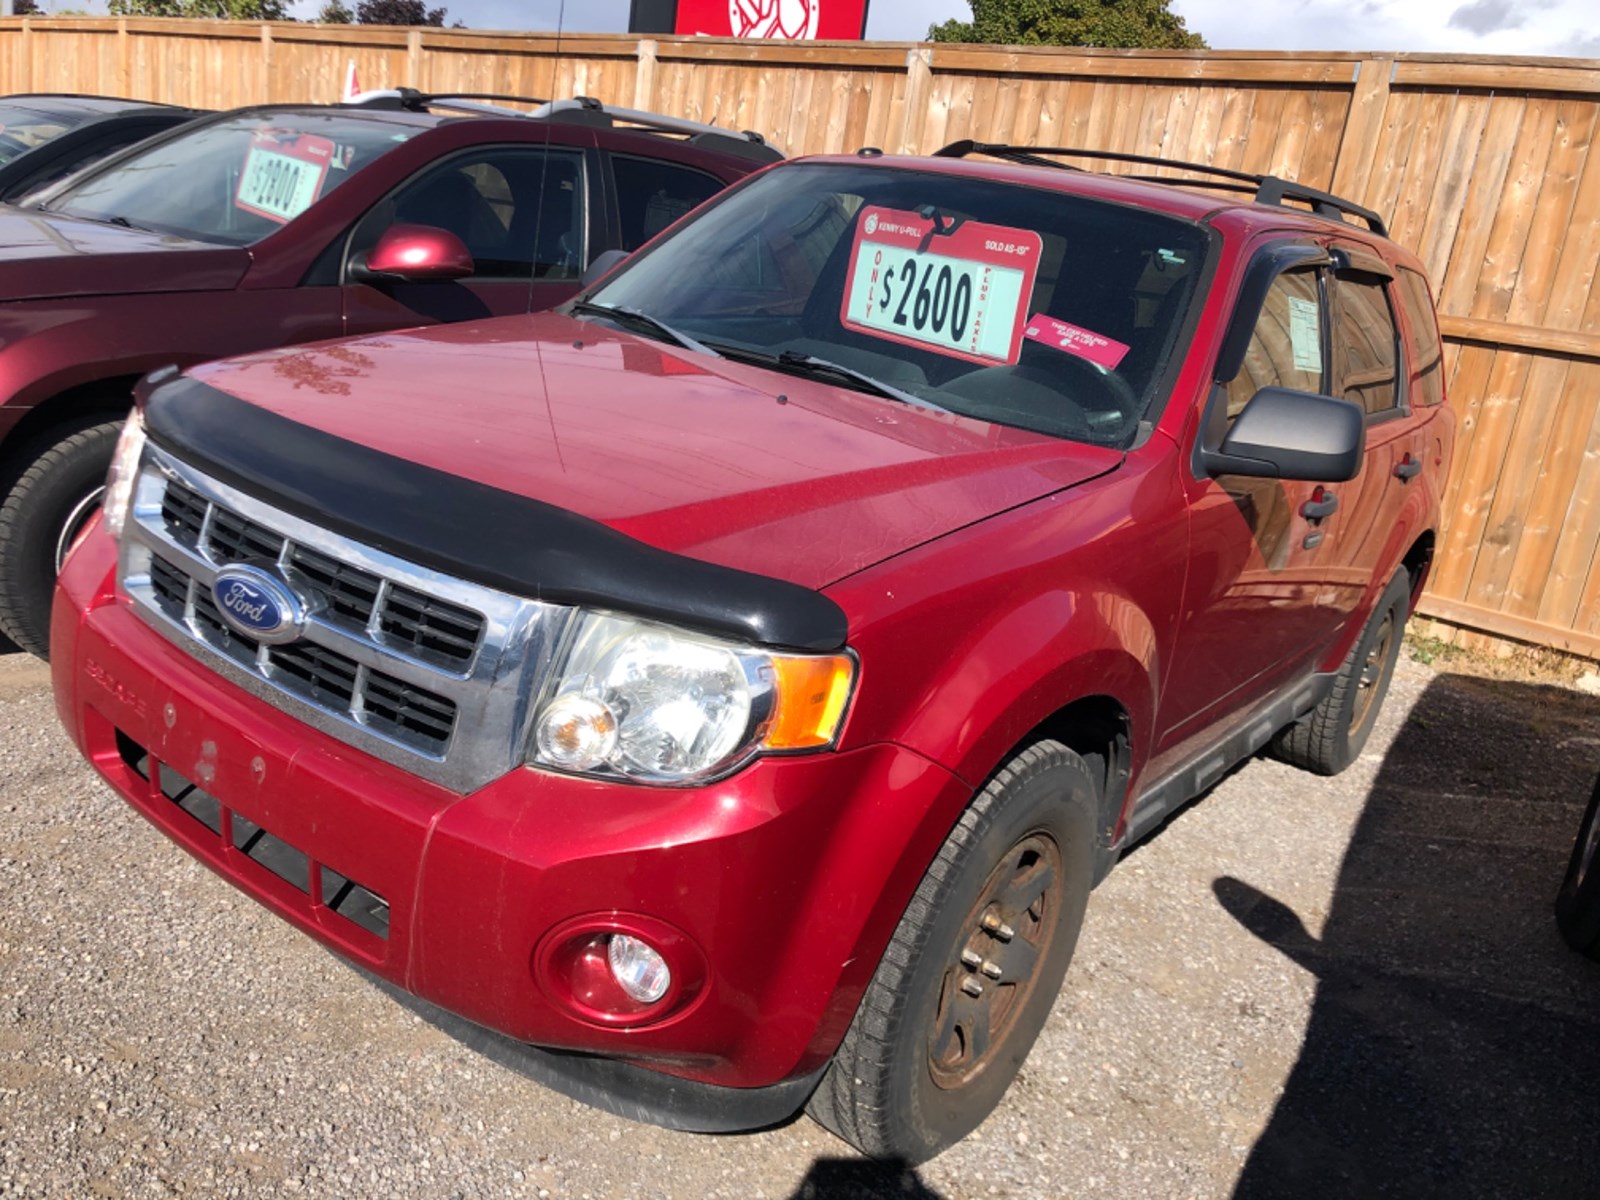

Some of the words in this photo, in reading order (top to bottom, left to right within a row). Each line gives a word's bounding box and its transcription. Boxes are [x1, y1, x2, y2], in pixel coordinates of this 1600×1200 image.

[878, 222, 899, 233] KENNY
[899, 226, 921, 238] U-PULL
[985, 240, 1004, 252] SOLD
[866, 250, 882, 319] ONLY
[879, 258, 972, 342] $2600
[979, 267, 991, 301] PLUS
[224, 582, 268, 622] Ford
